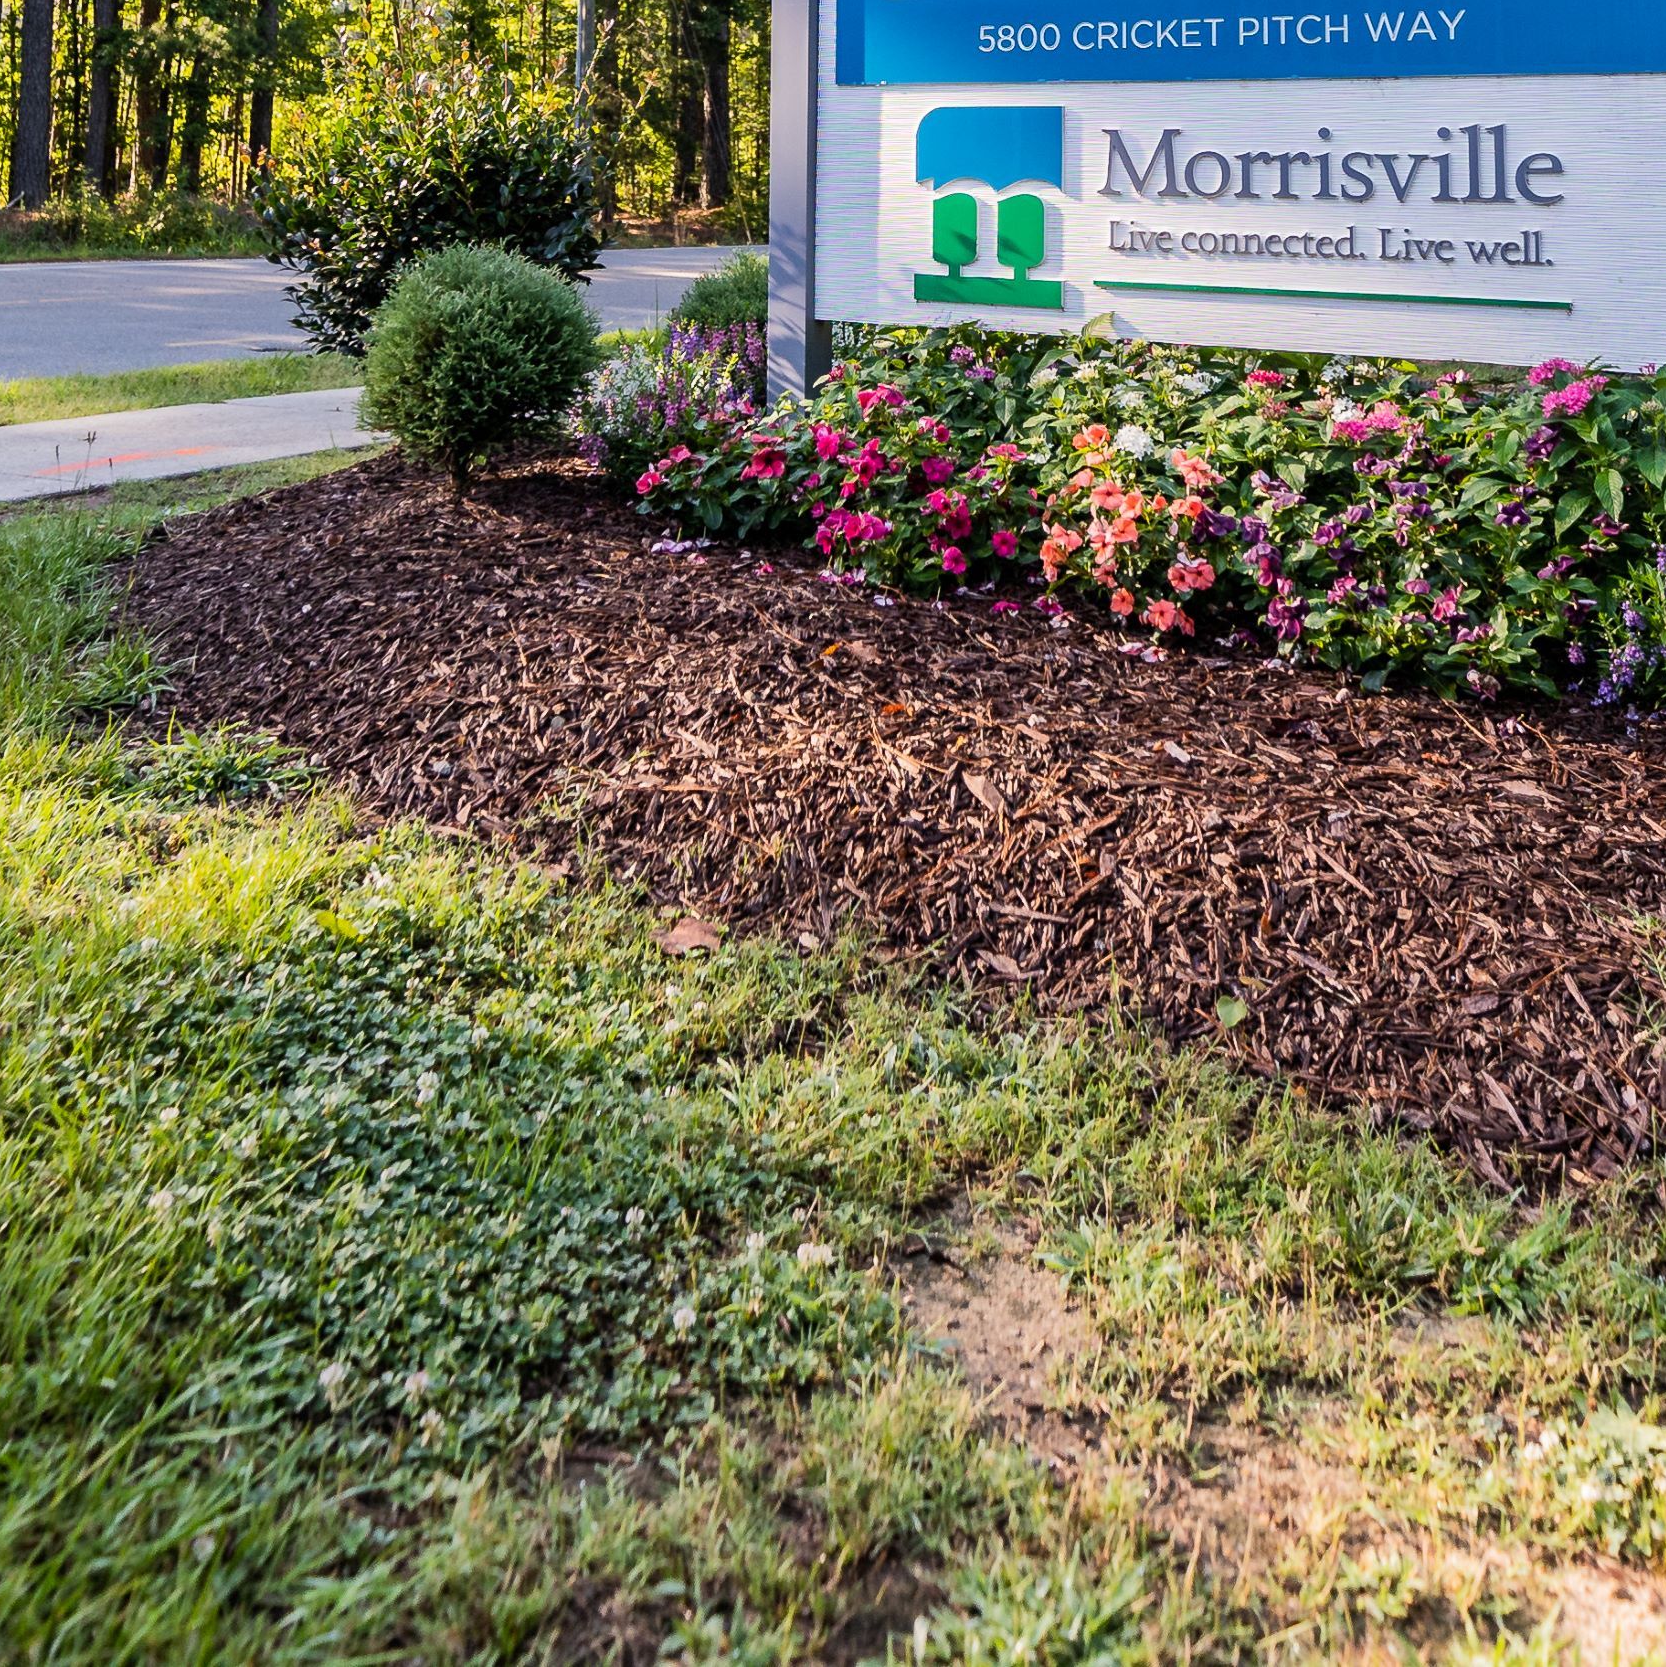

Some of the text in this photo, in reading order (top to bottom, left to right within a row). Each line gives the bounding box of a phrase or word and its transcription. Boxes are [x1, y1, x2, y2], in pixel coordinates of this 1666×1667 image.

[977, 9, 1467, 53] 5800 CRICKET PITCH WAY
[1096, 123, 1565, 206] Morrisville
[1108, 220, 1554, 267] Live connected. Live well.
